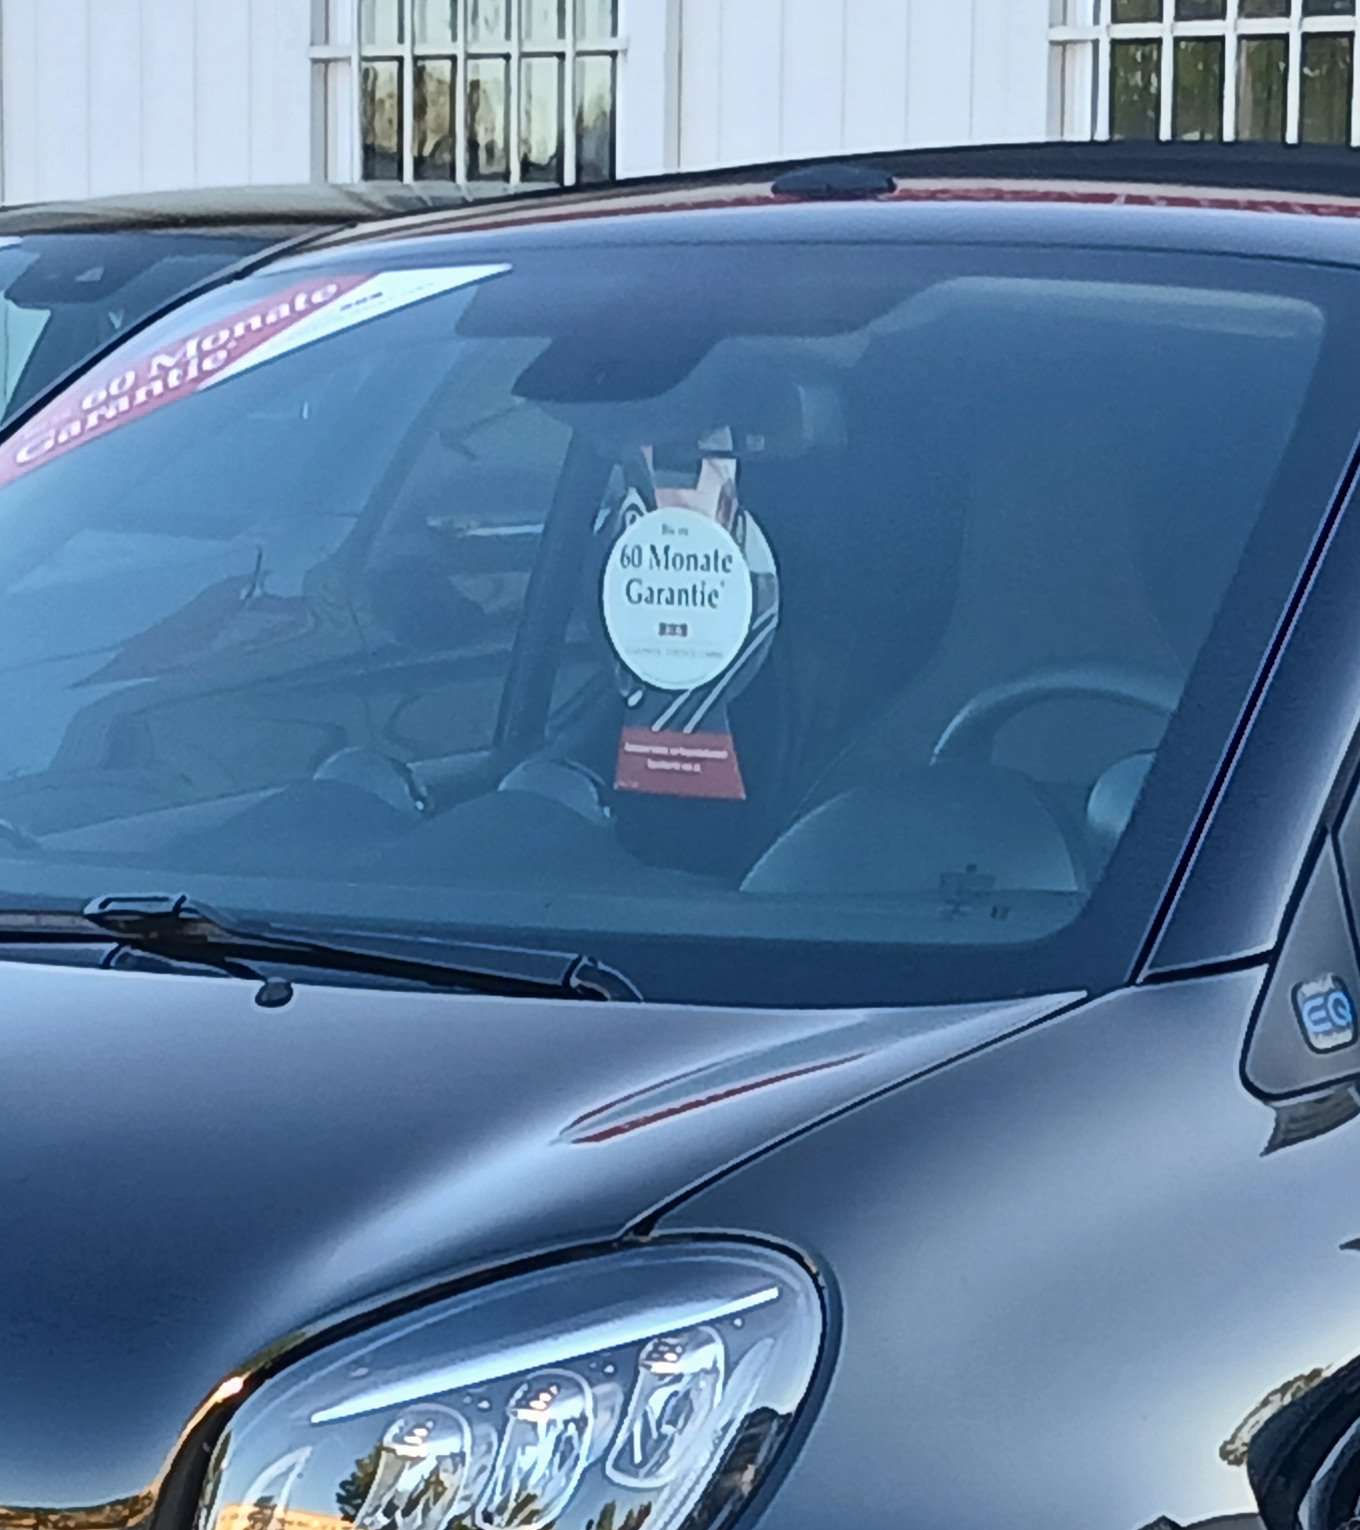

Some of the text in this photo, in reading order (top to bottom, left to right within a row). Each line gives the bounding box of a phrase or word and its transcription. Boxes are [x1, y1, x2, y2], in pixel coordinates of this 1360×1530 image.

[620, 544, 733, 574] 60 Monate
[1302, 991, 1353, 1033] EQ
